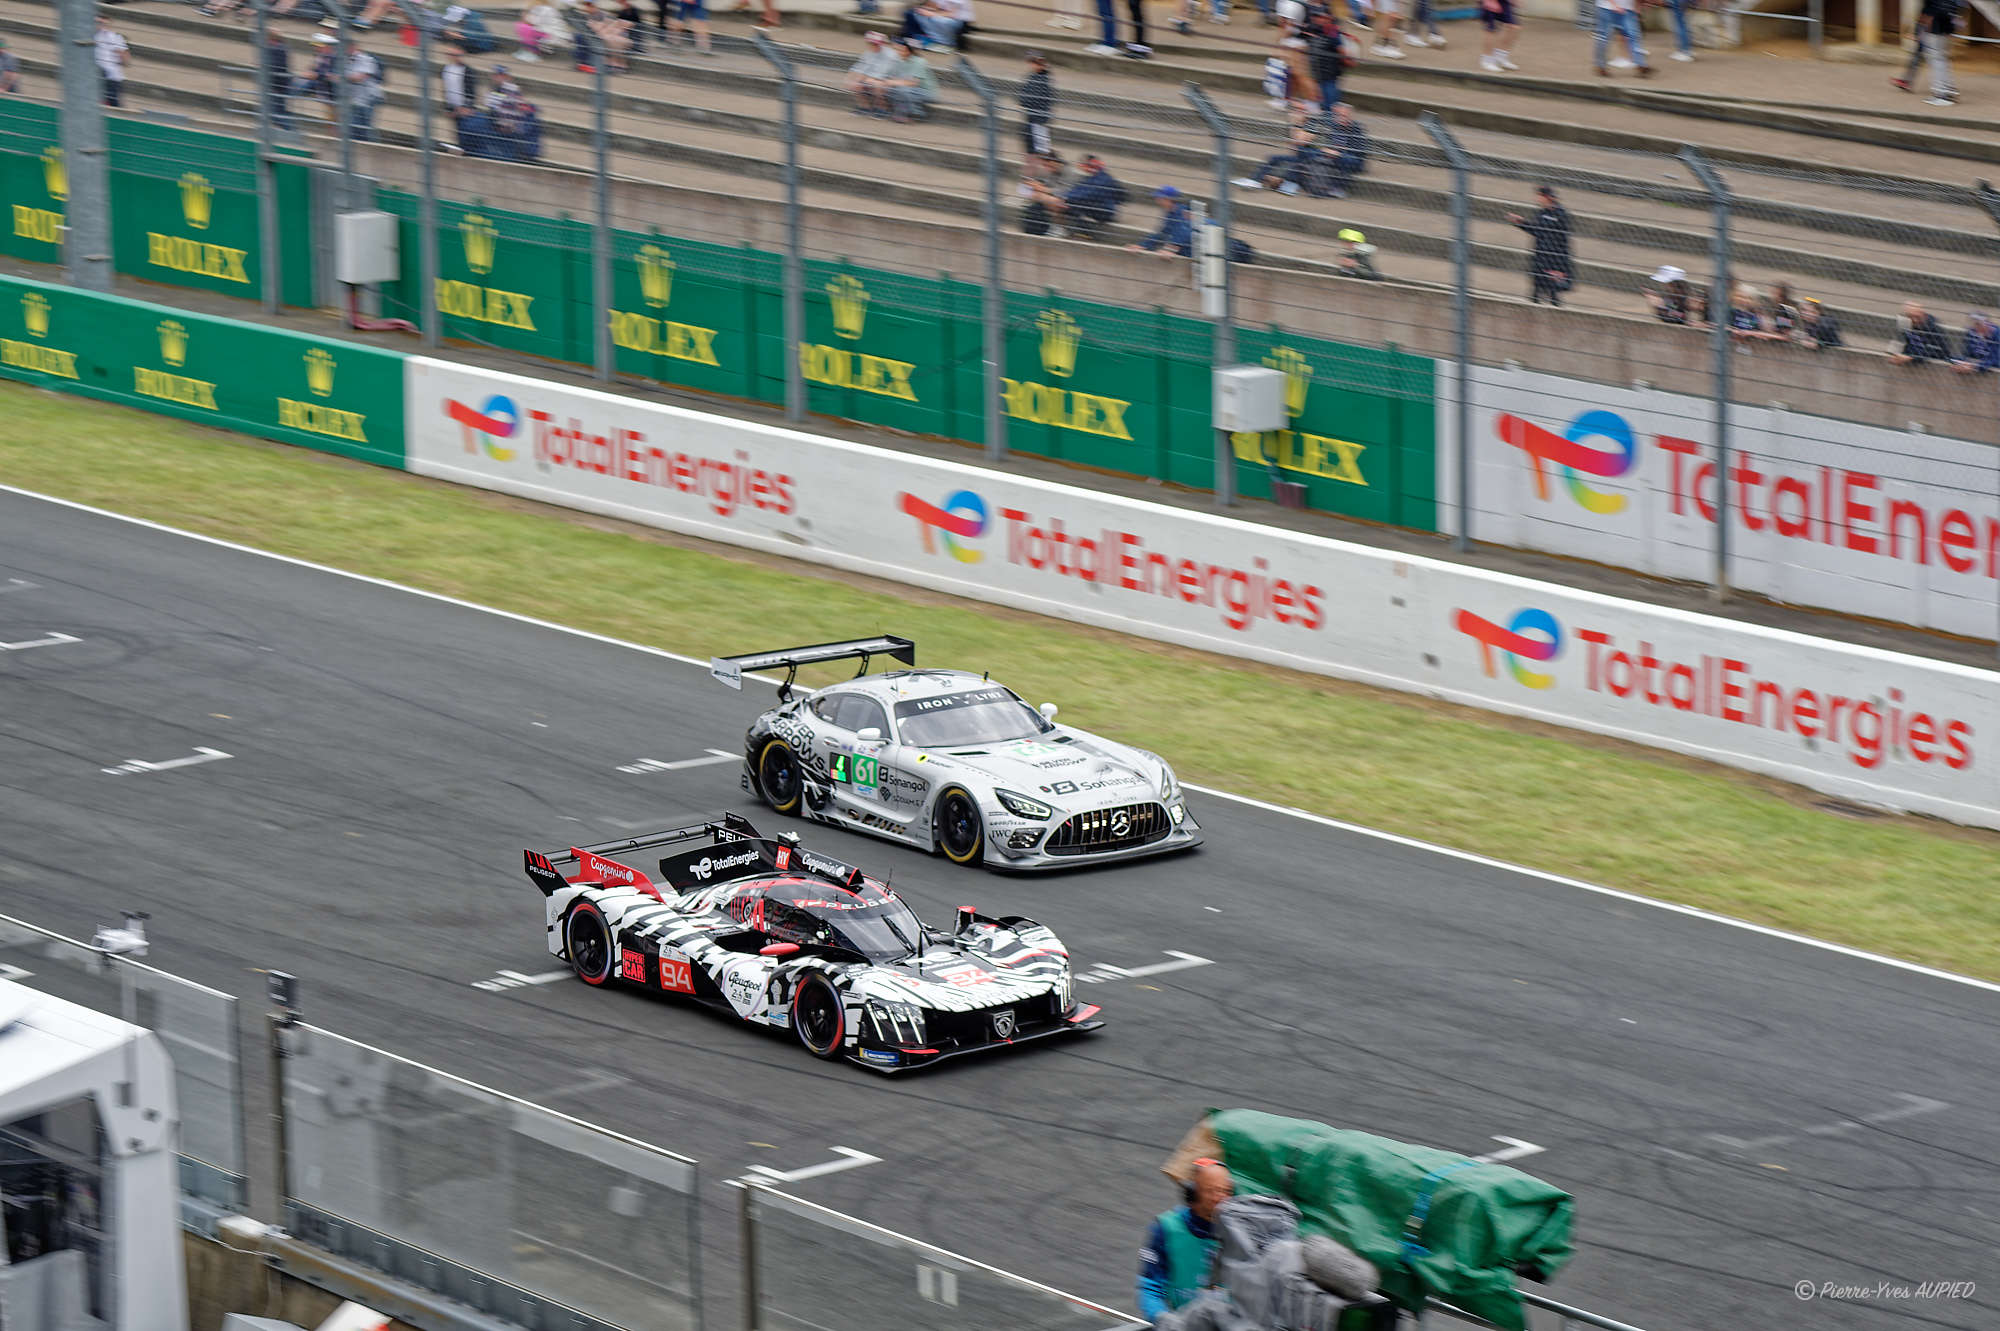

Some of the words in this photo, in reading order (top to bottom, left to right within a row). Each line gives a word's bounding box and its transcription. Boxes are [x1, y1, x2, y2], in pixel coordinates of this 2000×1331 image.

[146, 232, 250, 284] ROLEX
[134, 366, 219, 411] ROLEX
[277, 397, 369, 443] ROLEX
[525, 408, 798, 517] TotalEnergies
[1001, 507, 1327, 631] TotalEnergies
[916, 698, 953, 710] IRON
[974, 691, 1004, 701] LYNX
[1575, 627, 1976, 770] TotalEnergies
[855, 758, 875, 785] 61
[590, 856, 626, 879] Capgemini
[711, 850, 760, 871] TotalEnergies
[777, 851, 789, 866] HY
[801, 853, 837, 874] Capgemini
[529, 865, 556, 879] PEUGEOT
[624, 951, 643, 965] HYPER
[624, 961, 644, 980] CAR
[661, 962, 692, 991] 94
[728, 971, 762, 991] Peugeot
